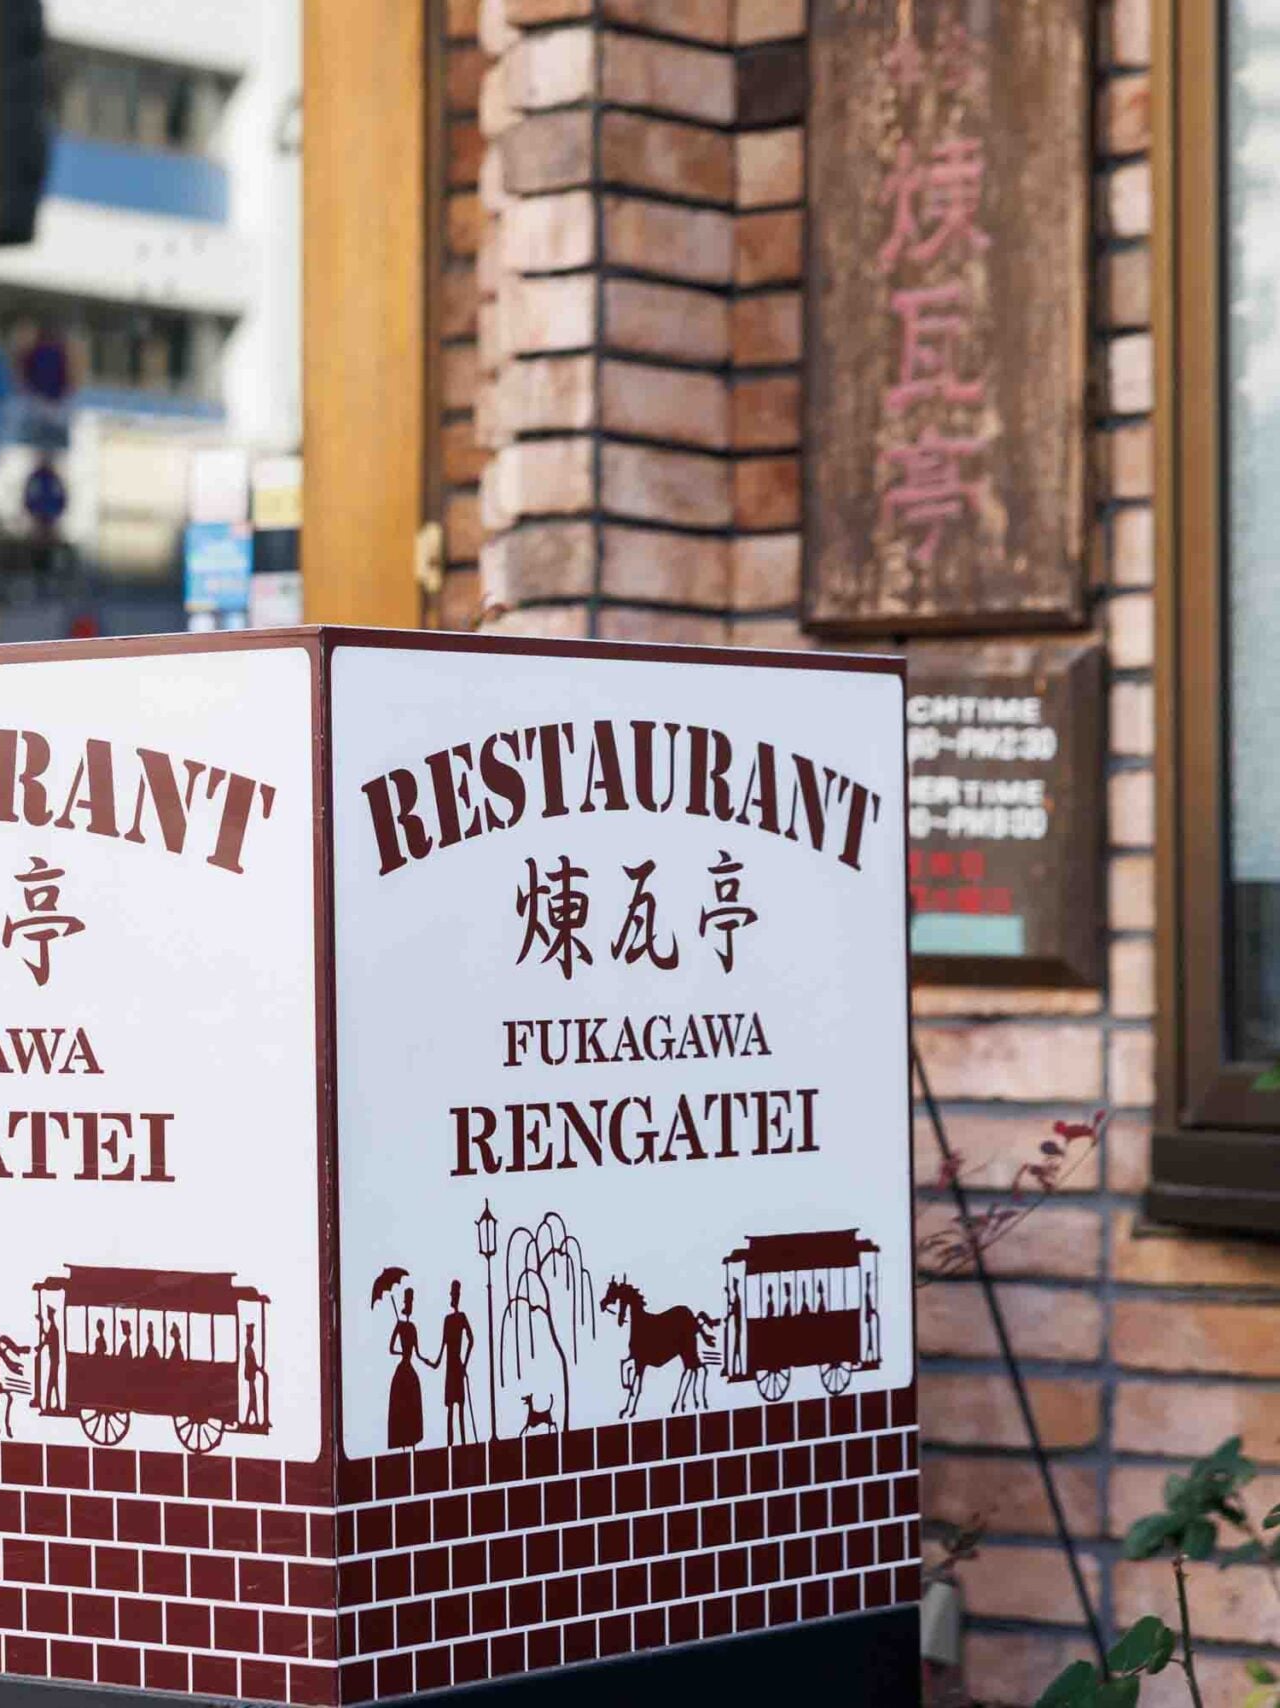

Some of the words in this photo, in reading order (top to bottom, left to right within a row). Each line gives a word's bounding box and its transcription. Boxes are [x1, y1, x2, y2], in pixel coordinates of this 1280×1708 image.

[361, 720, 881, 877] RESTAURANT
[515, 850, 758, 981] 煉瓦亭
[502, 1012, 772, 1067] FUKAGAWA
[449, 1088, 820, 1177] RENGATEI
